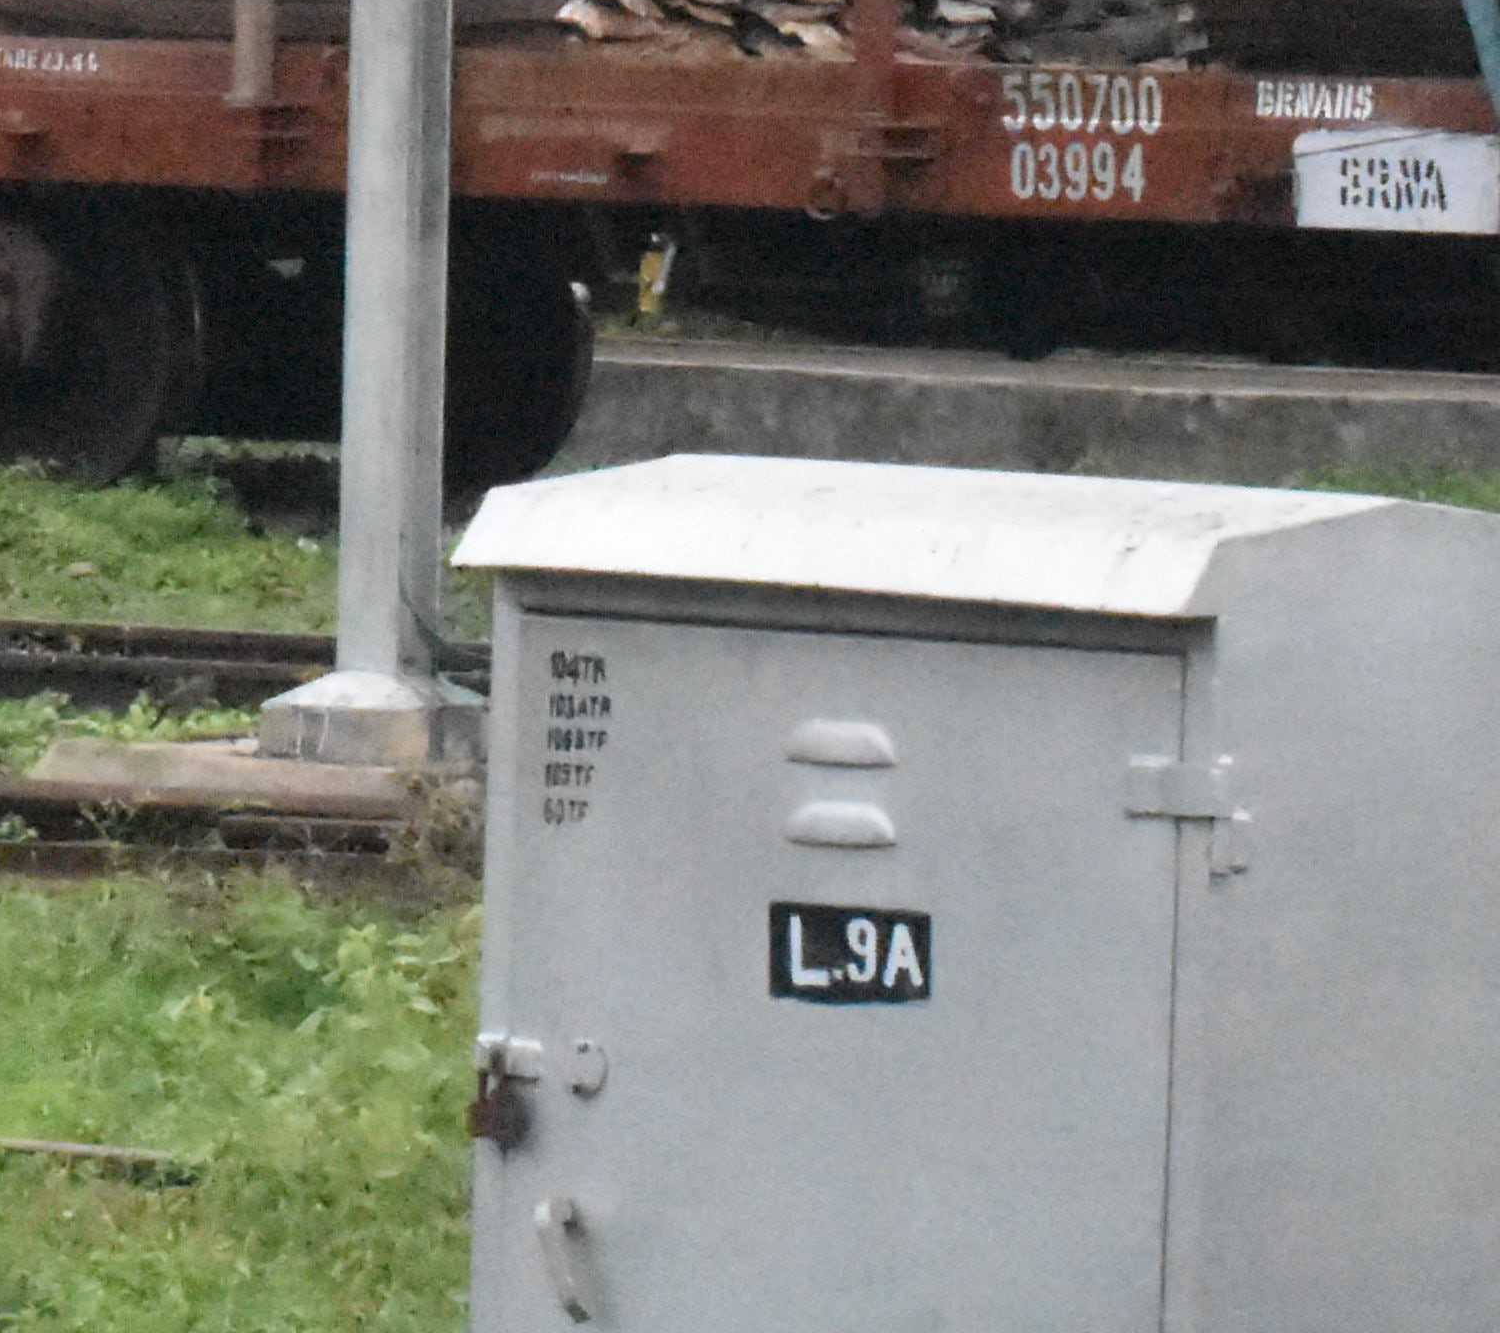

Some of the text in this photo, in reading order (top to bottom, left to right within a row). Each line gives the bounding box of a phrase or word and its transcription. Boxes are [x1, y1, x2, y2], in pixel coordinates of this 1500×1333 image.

[1001, 71, 1163, 135] 550700
[1010, 141, 1145, 202] 03994
[789, 913, 923, 988] L.9A
